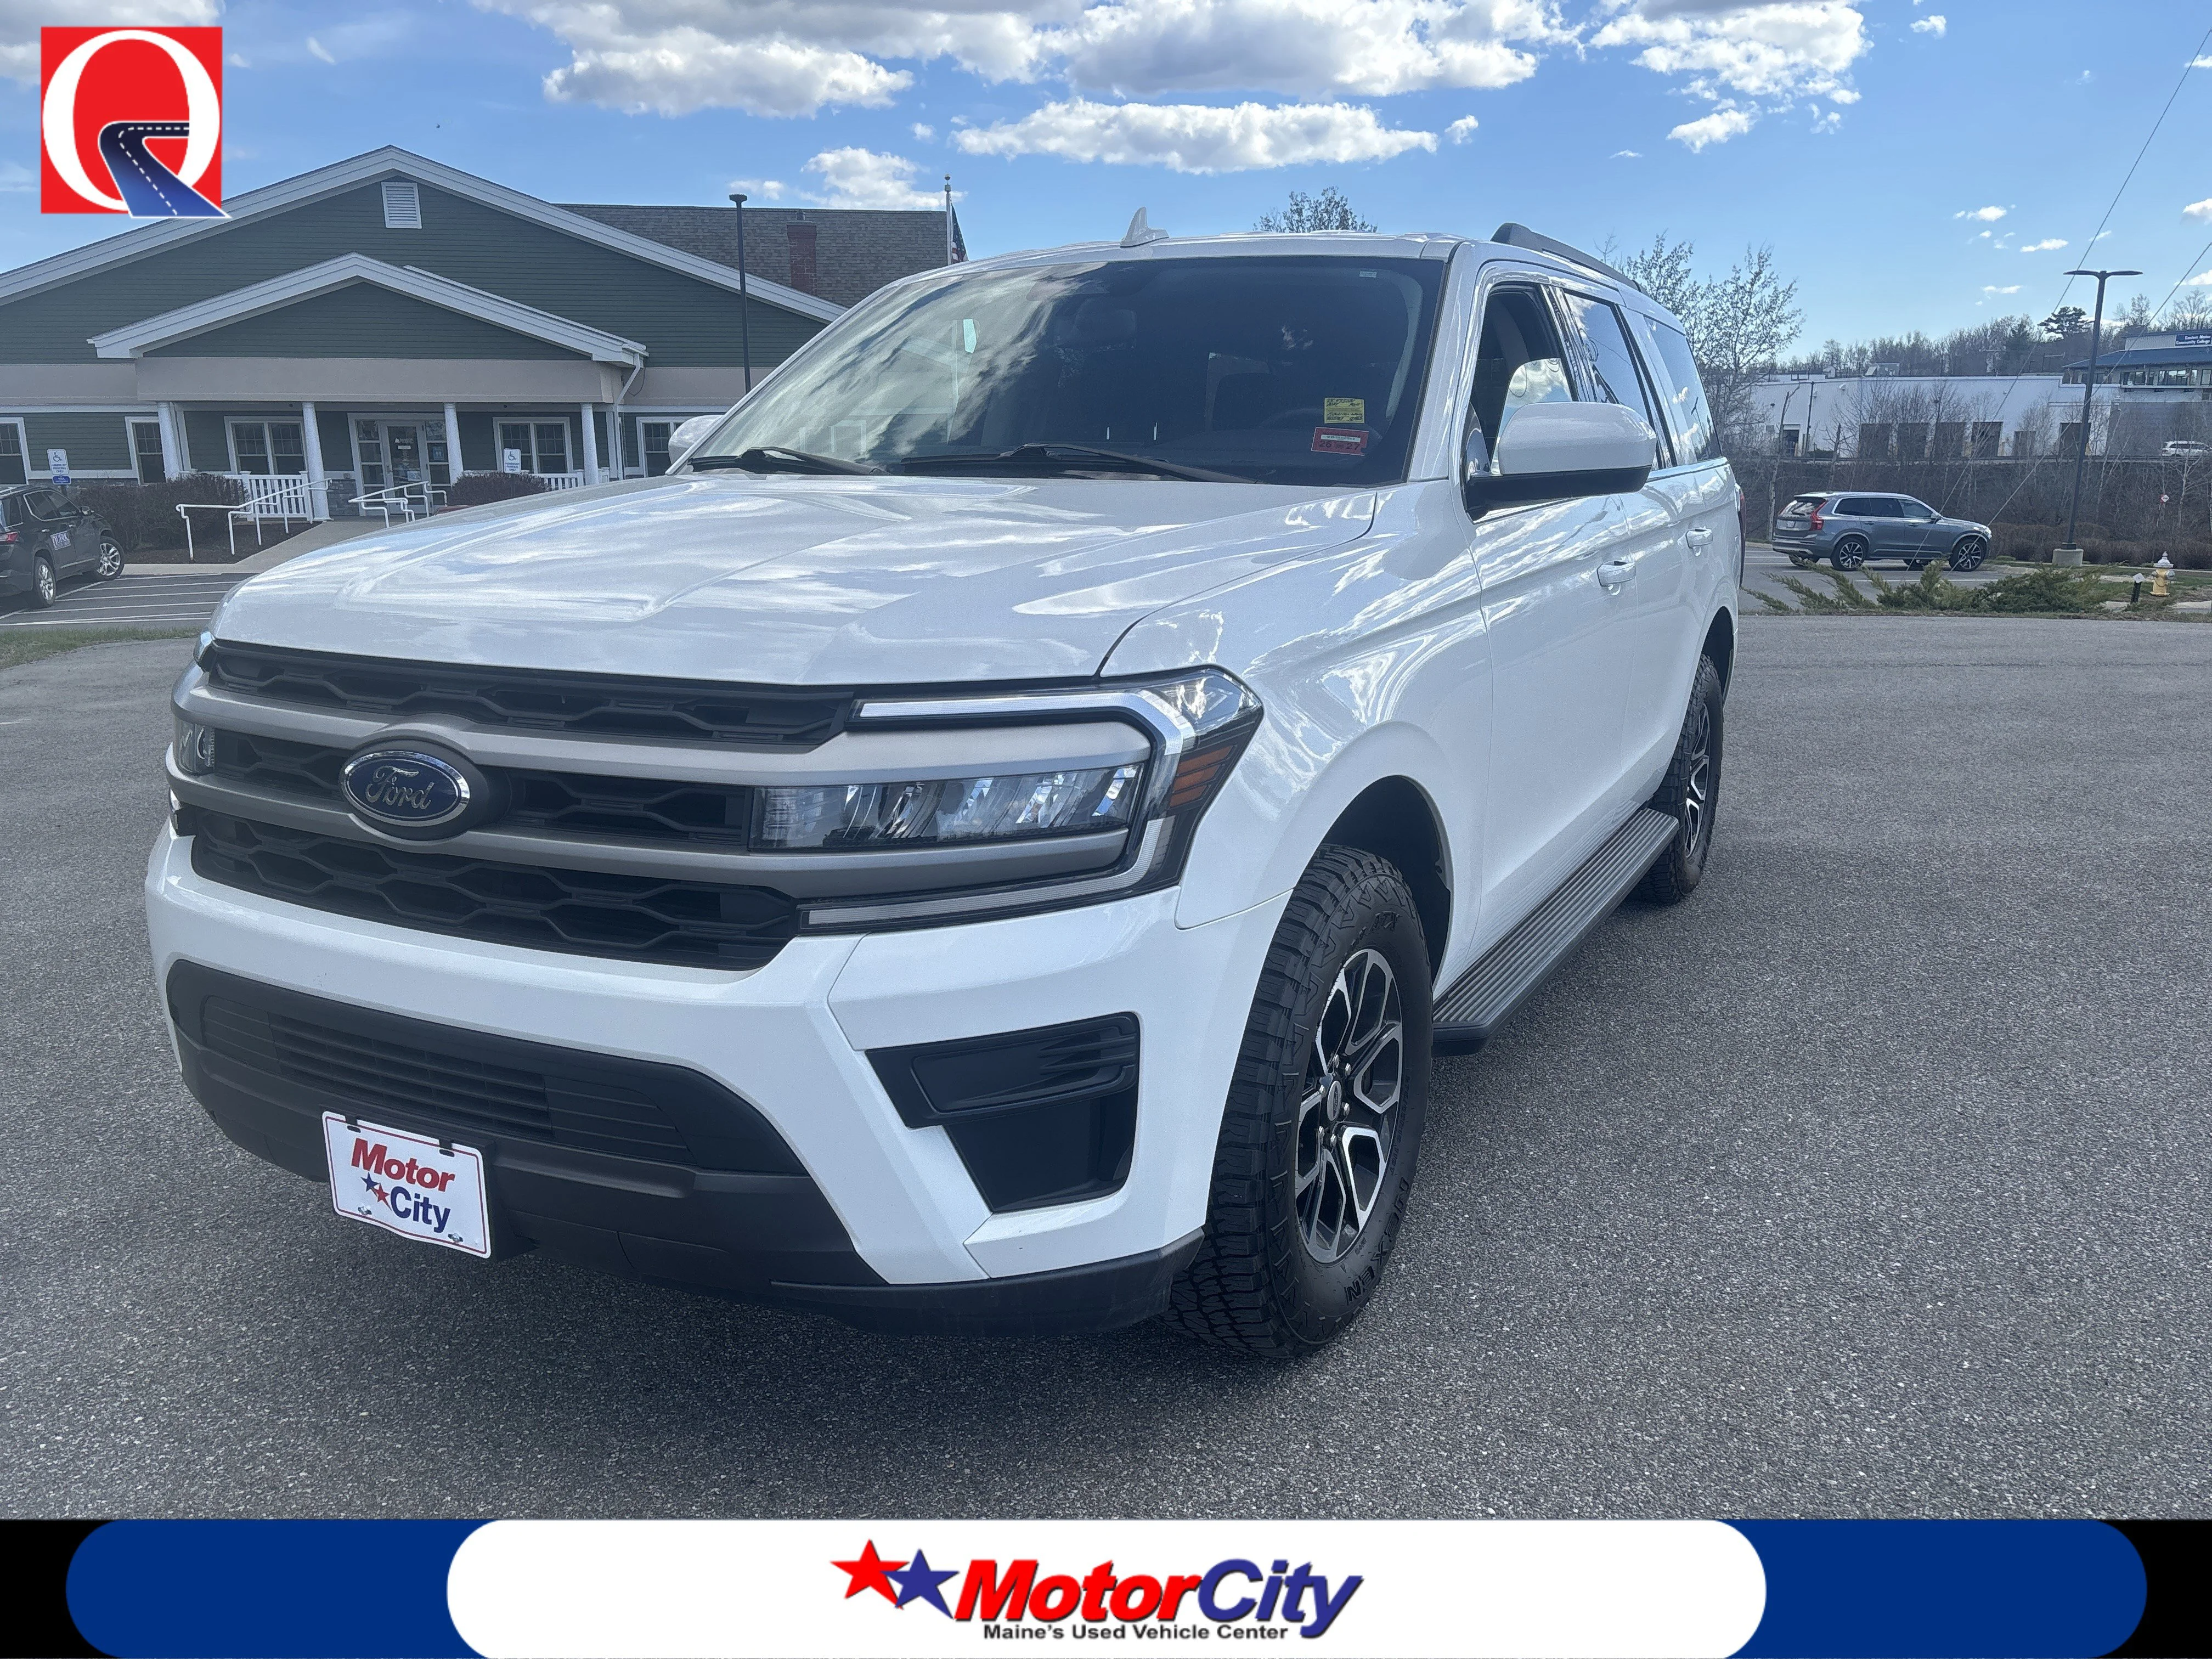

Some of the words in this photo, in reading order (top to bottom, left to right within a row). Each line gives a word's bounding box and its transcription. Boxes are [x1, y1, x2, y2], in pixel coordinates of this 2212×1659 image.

[365, 765, 436, 810] Ford
[351, 1138, 455, 1192] Motor
[390, 1186, 451, 1233] City
